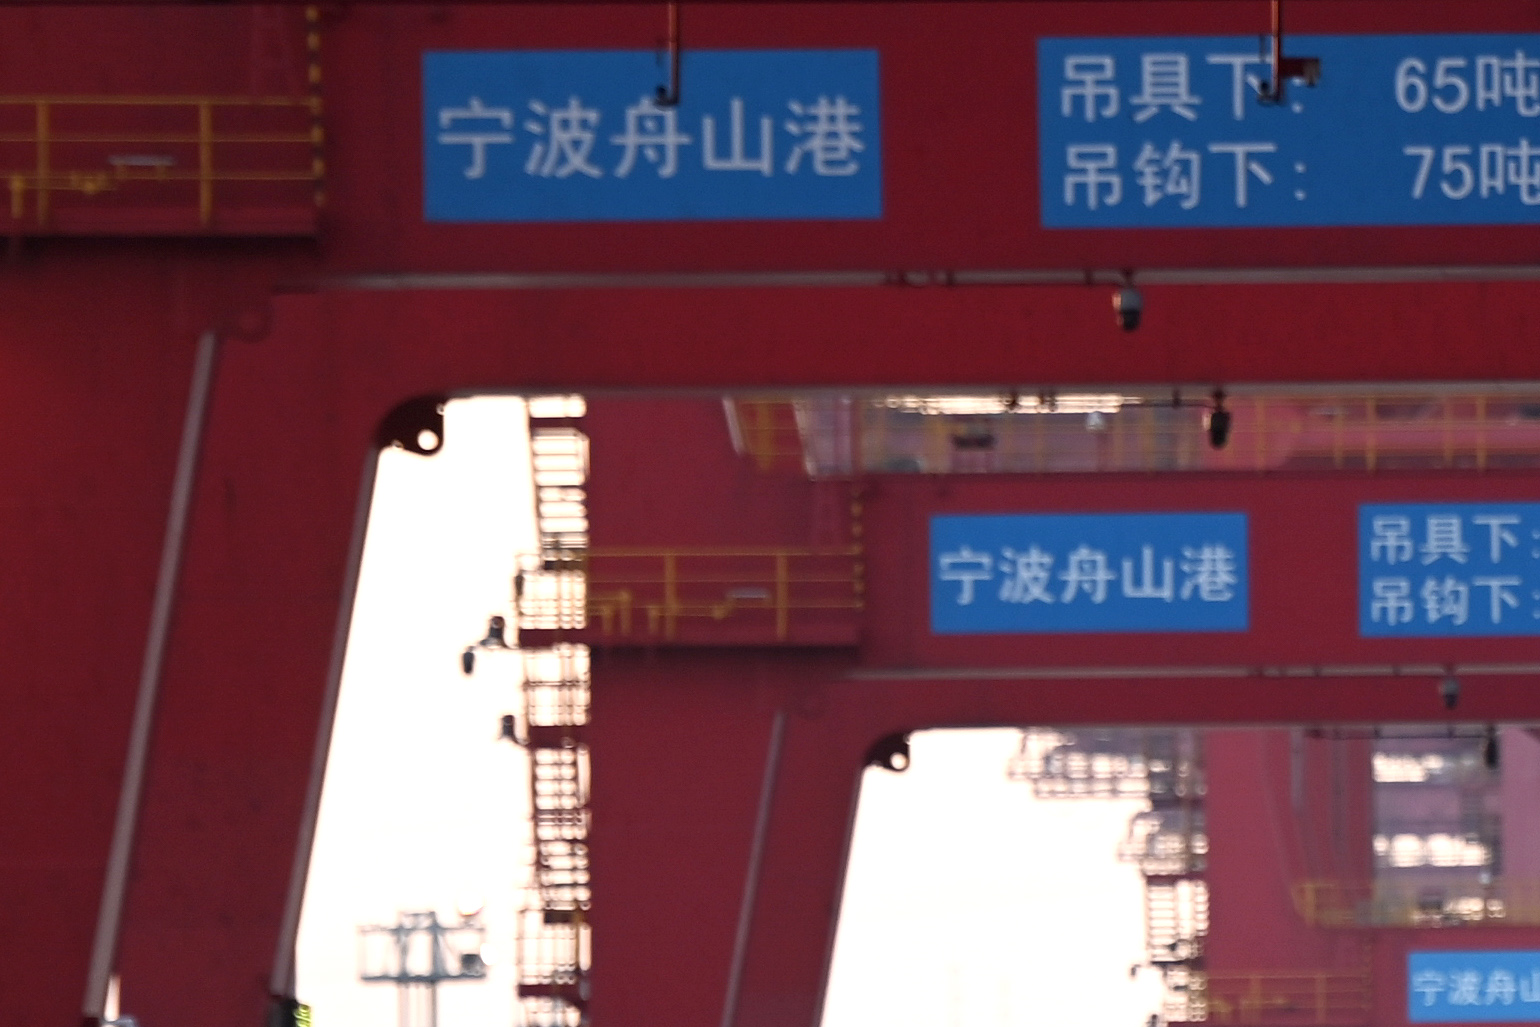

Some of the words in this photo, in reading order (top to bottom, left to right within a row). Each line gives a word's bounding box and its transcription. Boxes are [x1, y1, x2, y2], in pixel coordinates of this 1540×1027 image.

[437, 97, 865, 180] 宁波舟山港
[938, 543, 1238, 606] 宁波舟山港
